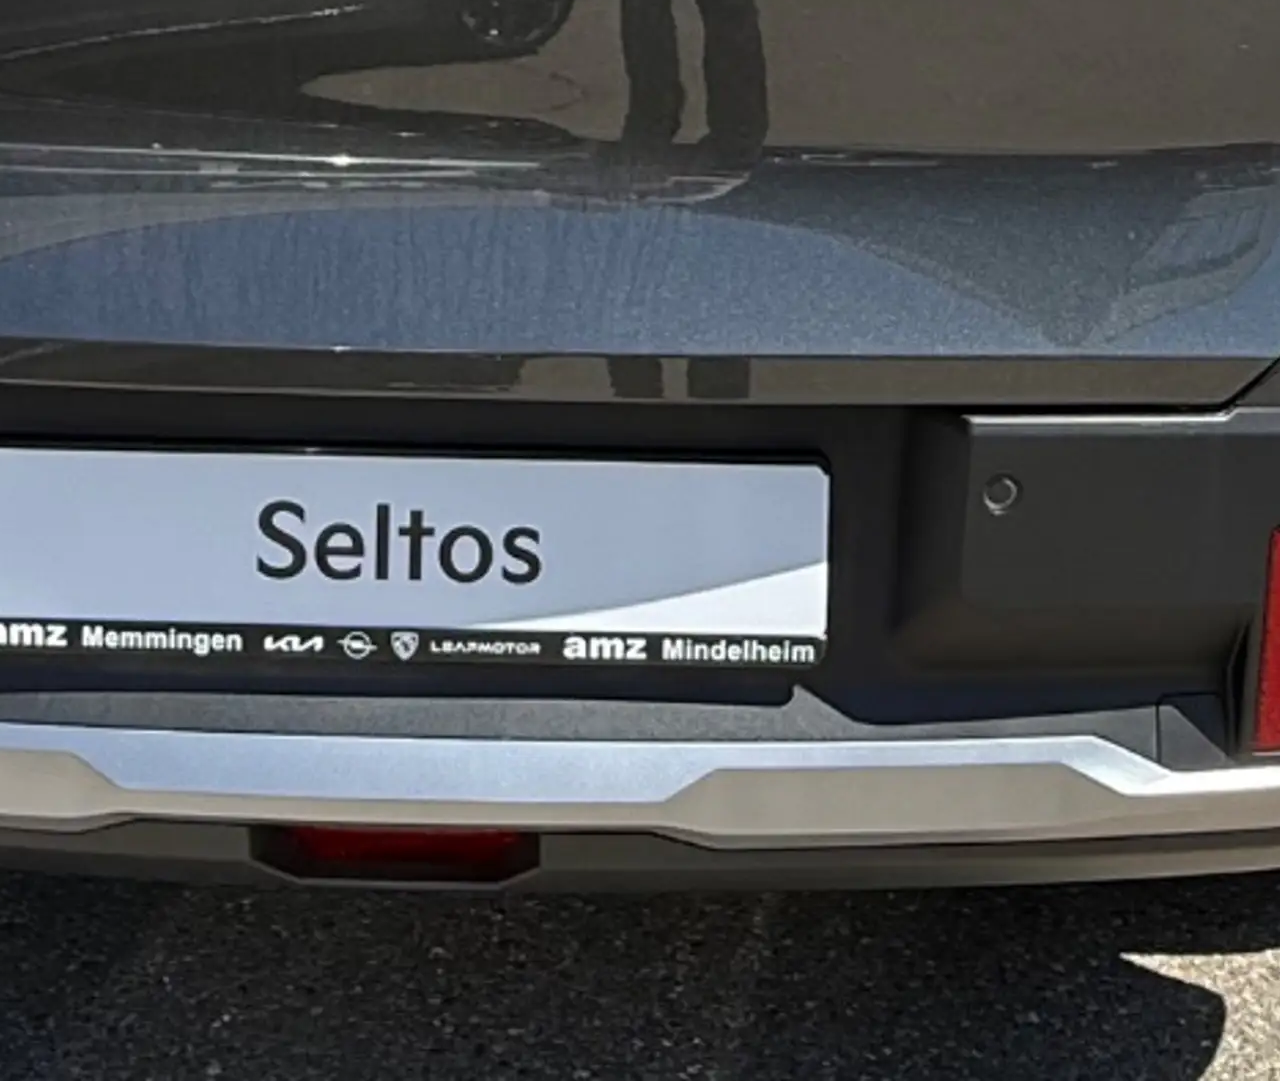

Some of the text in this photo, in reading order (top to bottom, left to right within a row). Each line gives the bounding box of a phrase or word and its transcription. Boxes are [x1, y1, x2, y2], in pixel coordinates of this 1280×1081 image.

[256, 499, 542, 585] Seltos
[81, 625, 243, 656] Memmingen
[563, 631, 647, 660] amz
[661, 637, 816, 663] Mindelheim
